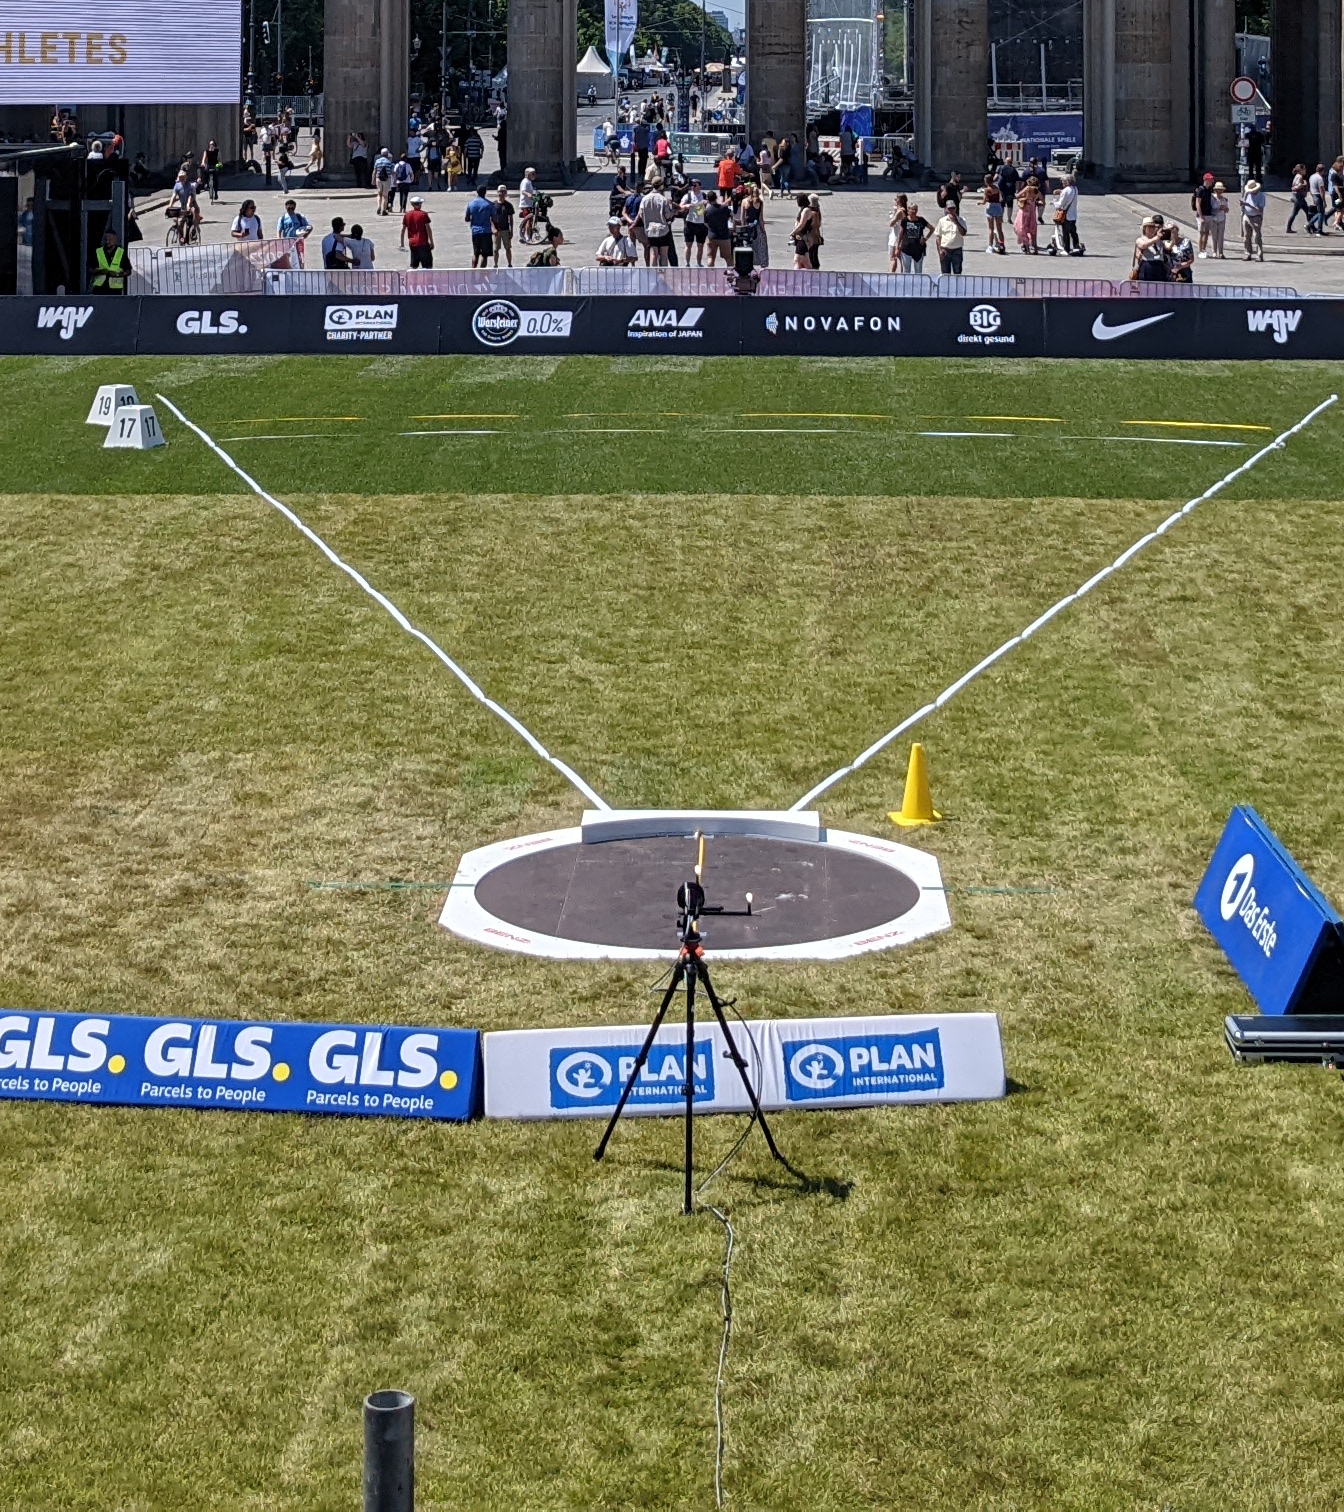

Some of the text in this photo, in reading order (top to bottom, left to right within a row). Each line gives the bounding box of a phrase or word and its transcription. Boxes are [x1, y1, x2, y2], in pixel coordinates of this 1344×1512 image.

[355, 309, 394, 320] PLAN
[628, 308, 679, 327] ANA
[785, 316, 901, 331] NOVAFON
[969, 311, 1001, 326] BIG
[326, 330, 393, 341] CHARITY-PARTNER
[628, 330, 667, 339] Inspiration
[678, 330, 703, 338] JAPAN
[957, 334, 1015, 345] direkt gesund
[98, 395, 112, 416] 19
[120, 417, 136, 438] 17
[144, 416, 156, 437] 17
[1252, 906, 1277, 958] Erste
[849, 1042, 937, 1071] PLAN
[34, 1076, 49, 1092] to
[52, 1078, 102, 1095] People
[852, 1072, 938, 1087] INTERNATIONAL
[141, 1081, 266, 1104] Parcels to People
[307, 1089, 434, 1112] Parcels to People
